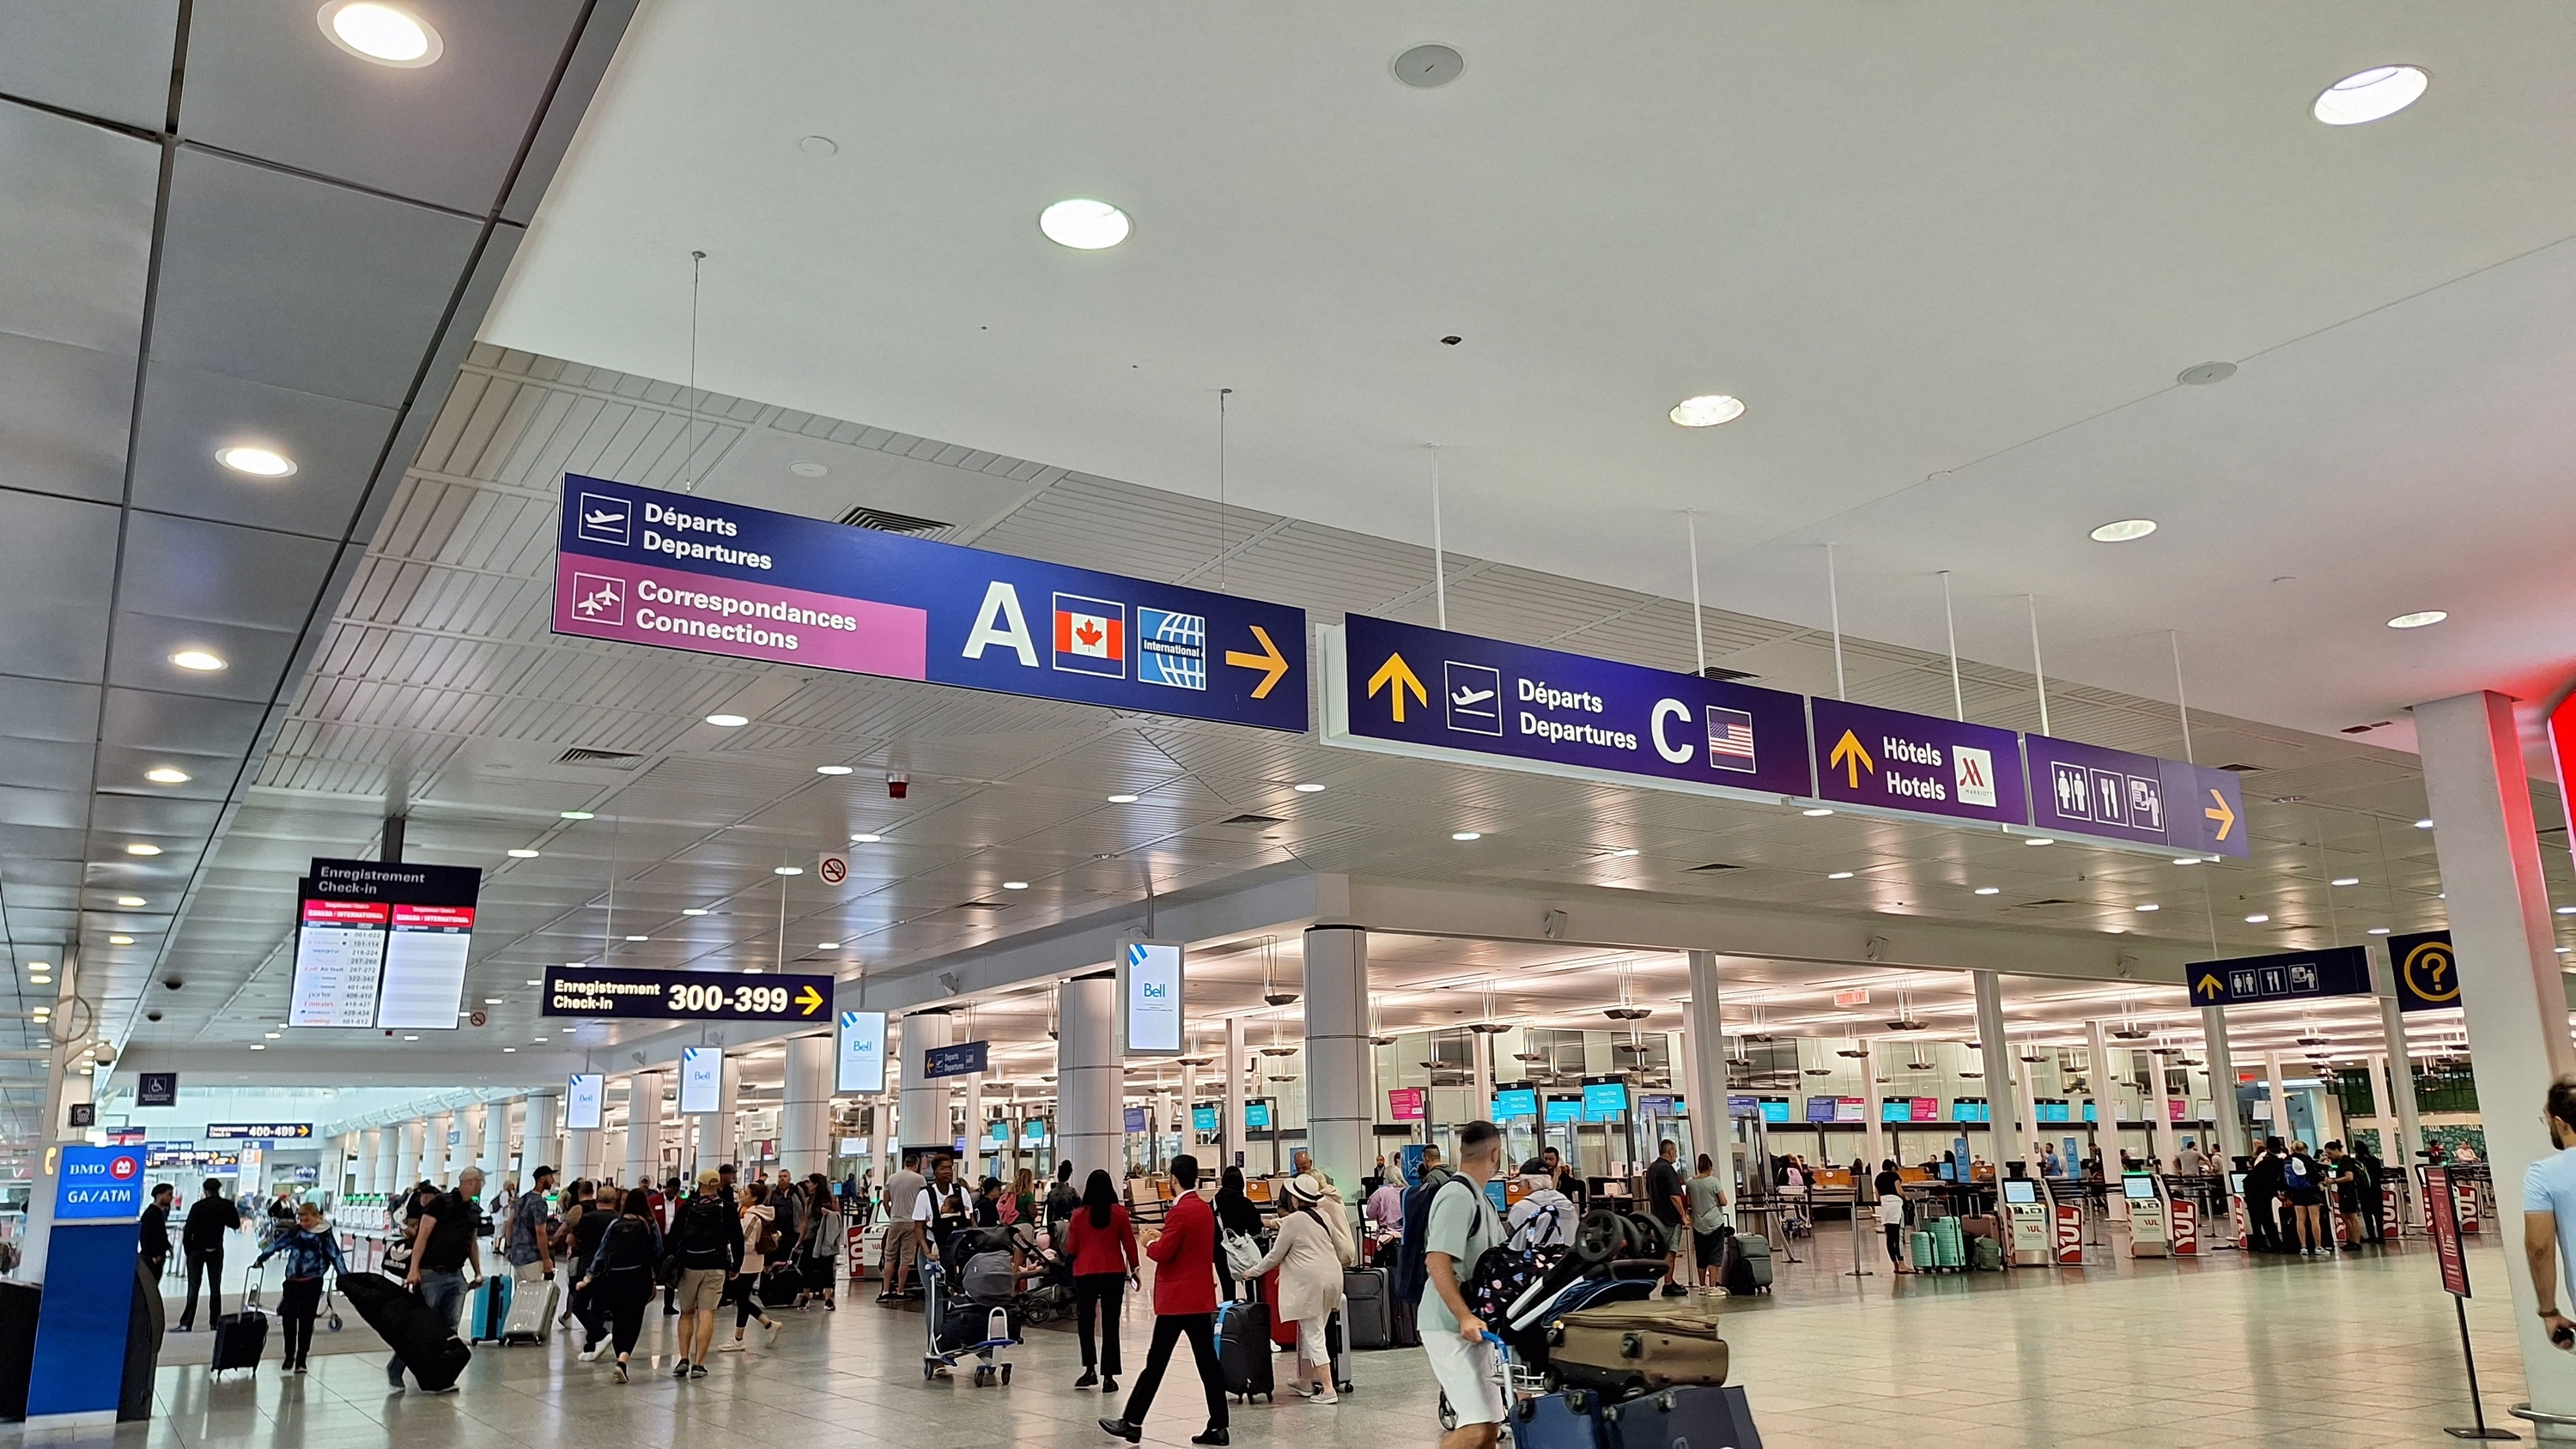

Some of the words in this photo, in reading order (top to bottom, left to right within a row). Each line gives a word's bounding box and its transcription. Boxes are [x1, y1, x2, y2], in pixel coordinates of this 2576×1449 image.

[645, 502, 738, 537] Départs
[643, 530, 773, 570] Departures
[637, 580, 858, 632] Correspondances
[635, 609, 799, 651] Connections
[962, 580, 1040, 668] A
[1144, 640, 1200, 658] International
[1518, 678, 1603, 713] Départs
[1520, 712, 1637, 750] Departures
[1650, 698, 1694, 764] C
[1882, 737, 1942, 767] Hôtels
[1886, 771, 1946, 802] Hotels
[1965, 788, 1992, 797] MARRIOTT
[319, 881, 377, 895] Check-in
[321, 866, 426, 884] Enregistrement
[555, 979, 660, 996] Enregistrement
[667, 984, 788, 1013] 300-399
[1144, 983, 1165, 997] Bell
[553, 996, 613, 1010] Check-in
[854, 1040, 872, 1052] Bell
[695, 1071, 710, 1080] Bell
[69, 1163, 105, 1175] BMO
[68, 1189, 131, 1203] GA/ATM
[2058, 1211, 2081, 1256] YUL
[2174, 1205, 2195, 1247] YUL
